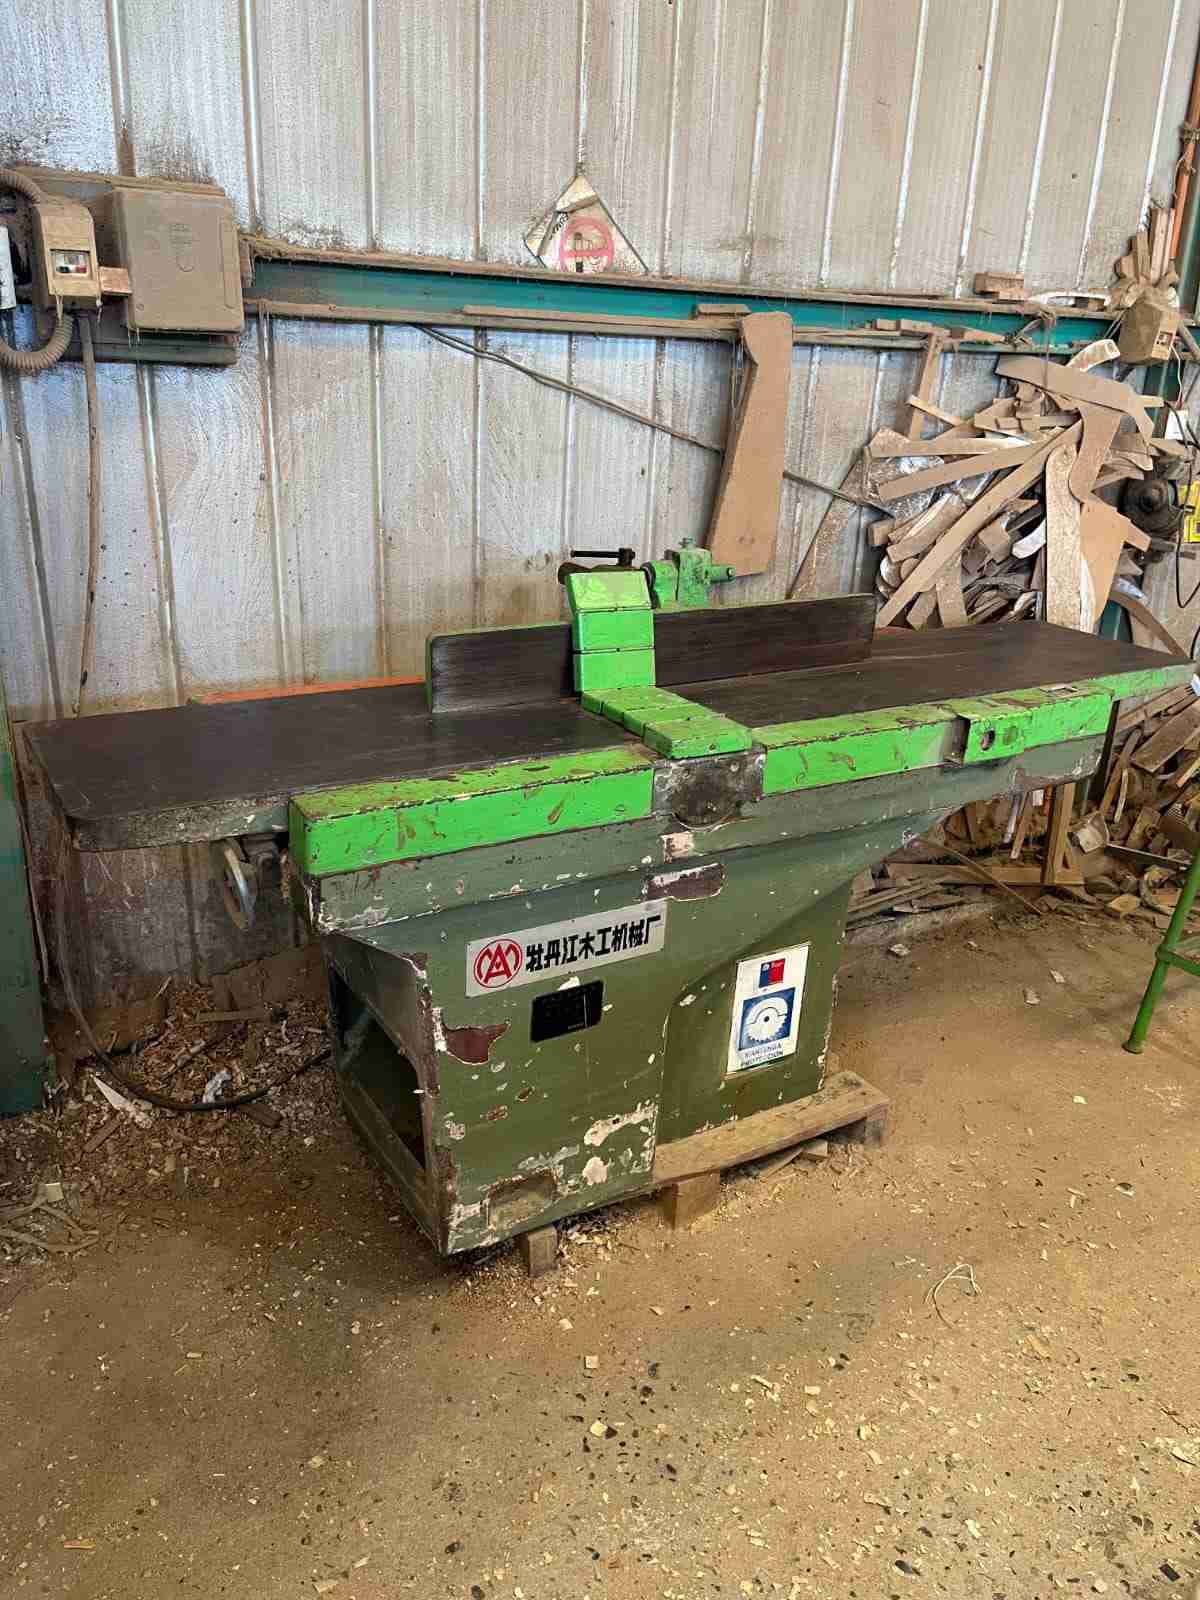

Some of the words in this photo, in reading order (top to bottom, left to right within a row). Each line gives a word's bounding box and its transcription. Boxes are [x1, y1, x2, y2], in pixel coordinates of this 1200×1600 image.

[525, 915, 662, 973] 牡丹江木工机械厂
